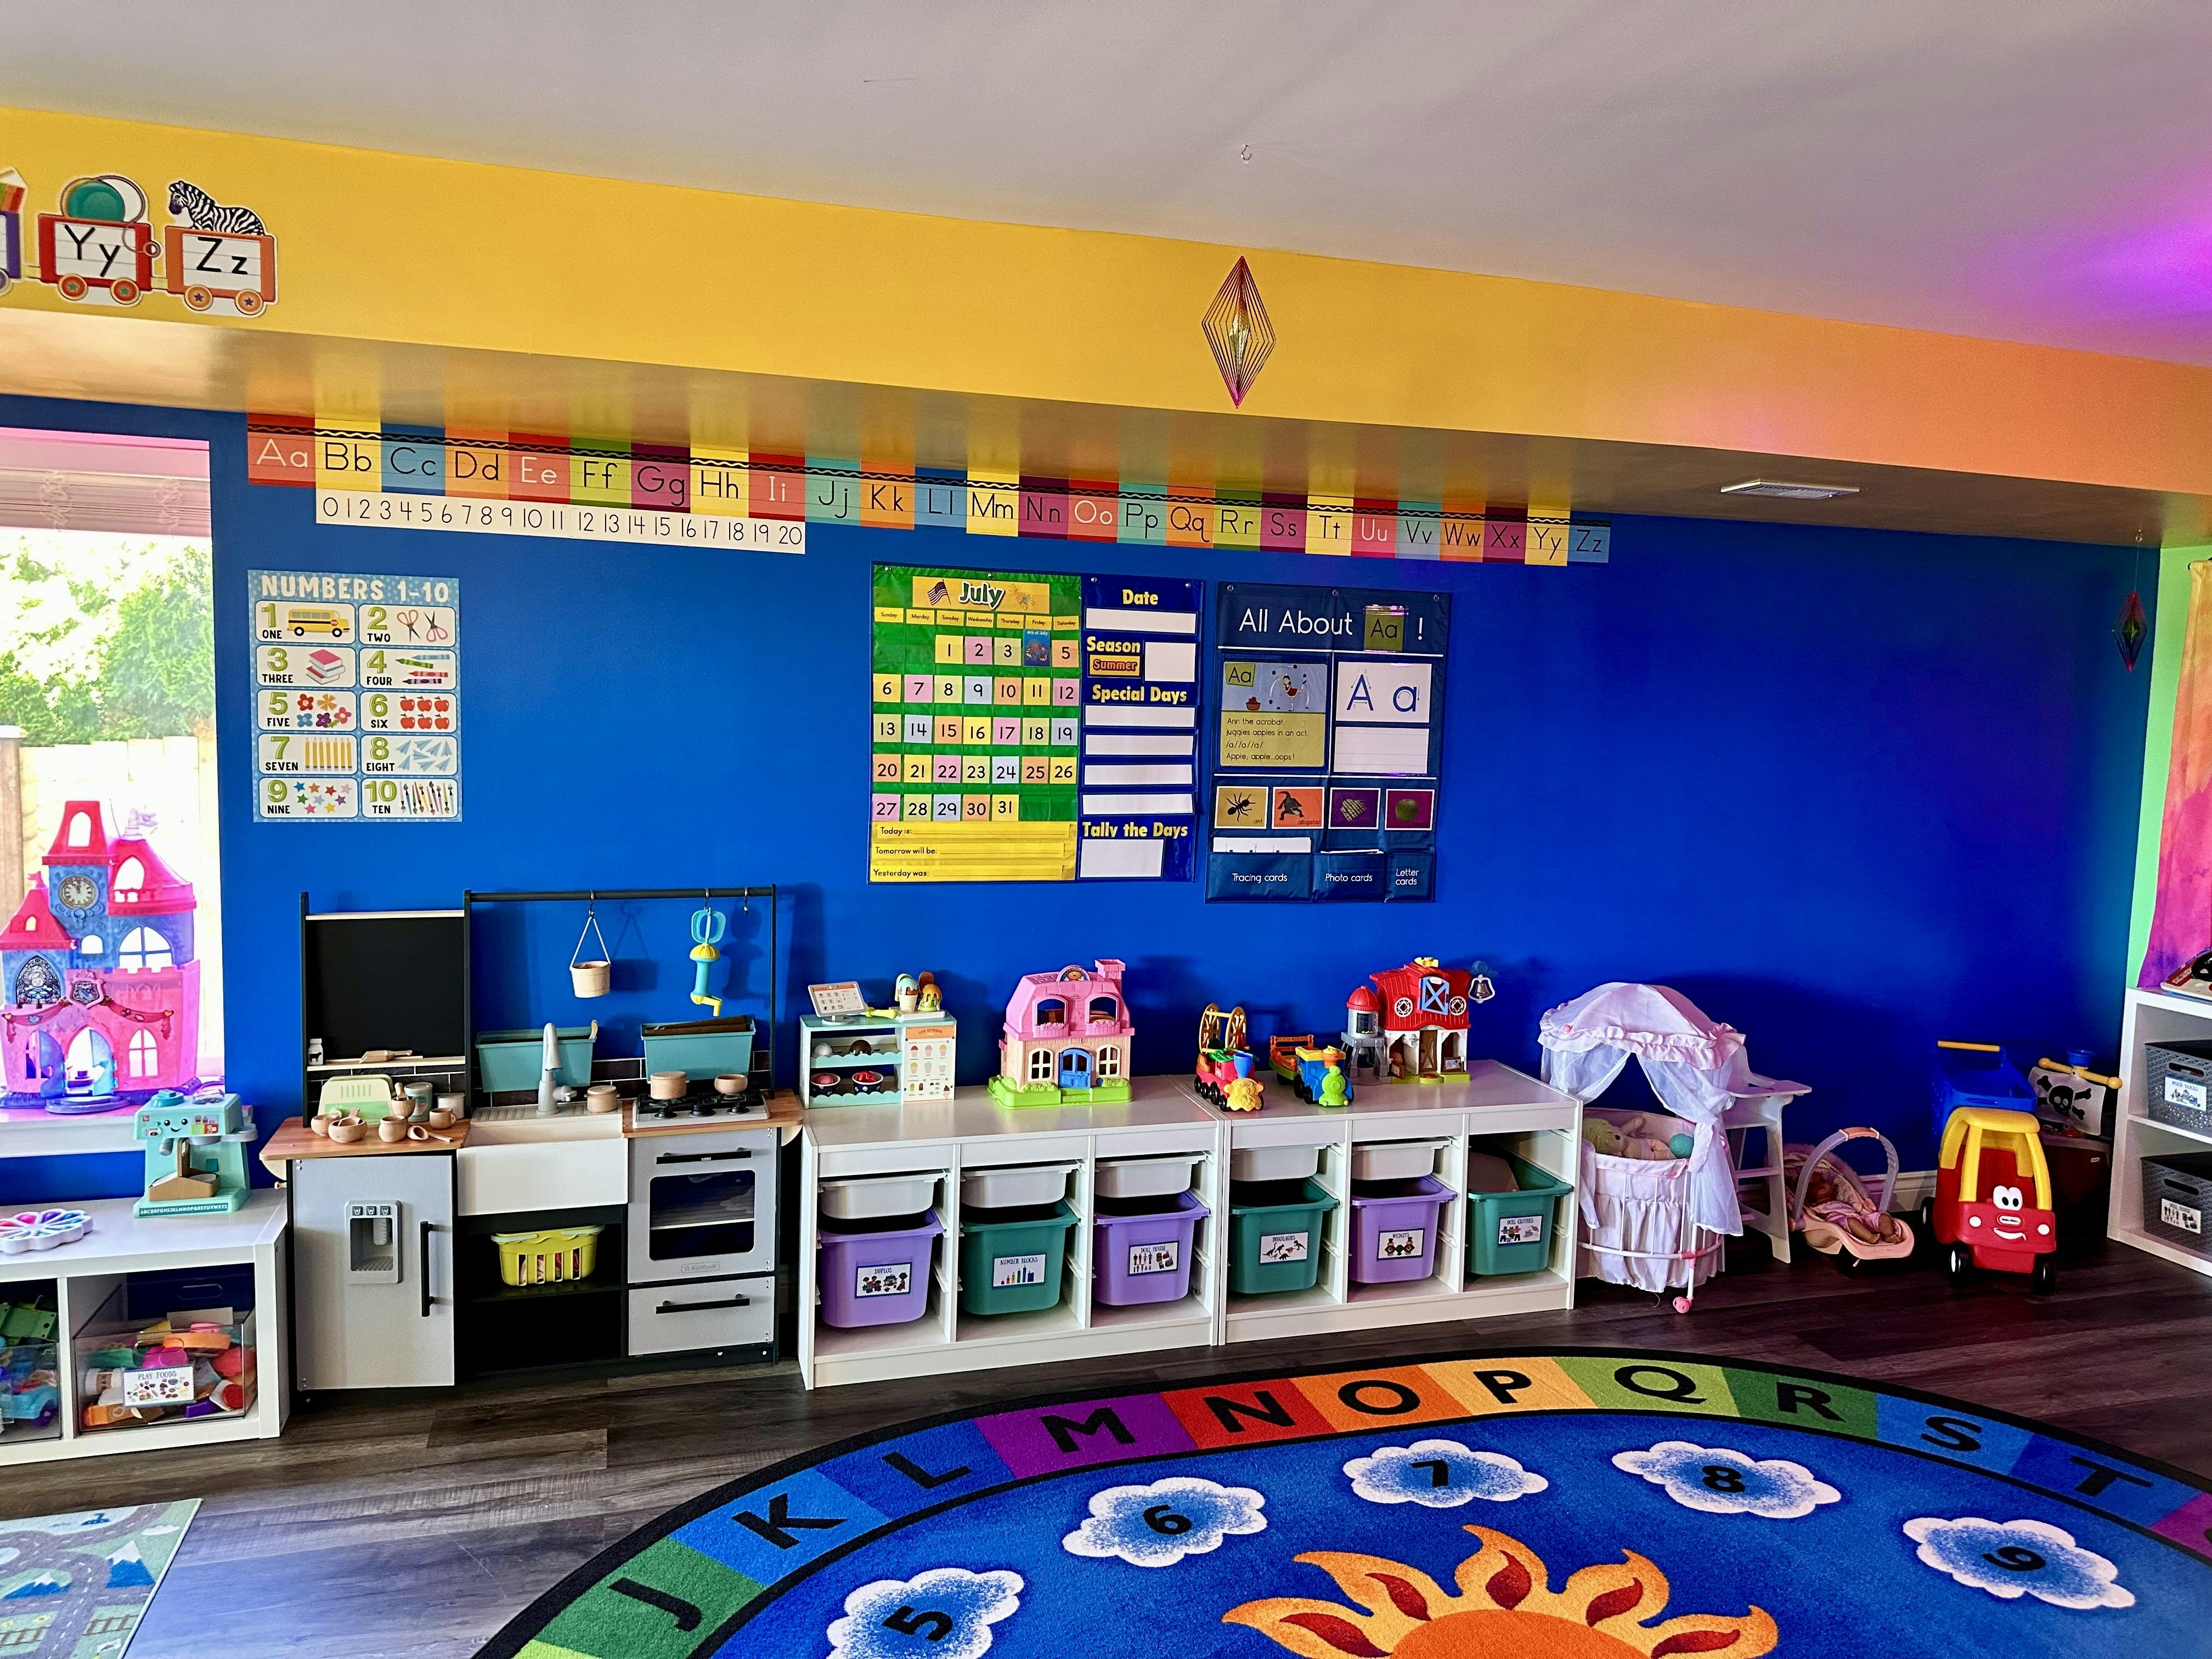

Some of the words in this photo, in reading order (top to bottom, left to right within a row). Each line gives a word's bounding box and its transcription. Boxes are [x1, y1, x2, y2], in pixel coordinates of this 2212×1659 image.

[64, 224, 120, 278] Yy
[196, 236, 248, 274] Zz
[256, 438, 308, 469] Aa
[325, 442, 371, 471] Bb
[391, 447, 436, 476] Cc
[455, 451, 499, 481] Dd
[521, 456, 557, 485] Ee
[583, 460, 618, 489] Ff
[637, 465, 685, 506] Gg
[701, 470, 738, 499] Hh
[769, 476, 786, 503] Ii
[818, 480, 849, 519] Jj
[871, 484, 904, 512] Kk
[928, 488, 953, 515] Ll
[972, 492, 1014, 520] Mm
[1026, 496, 1060, 523] Nn
[1074, 500, 1112, 526] Oo
[1125, 503, 1159, 539] Pp
[1170, 506, 1209, 543] Qq
[1220, 510, 1254, 536] Rr
[1269, 512, 1297, 537] Ss
[1318, 515, 1340, 540] Tt
[1361, 518, 1389, 543] Uu
[1406, 521, 1433, 545] Vv
[1444, 522, 1481, 547] Ww
[1491, 525, 1520, 549] Xx
[1533, 527, 1562, 561] Yy
[1576, 530, 1601, 554] Zz
[261, 574, 385, 601] NUMBERS
[398, 582, 449, 602] 1-10
[960, 582, 1005, 610] July
[1122, 589, 1158, 605] Date
[261, 603, 276, 628] 1
[367, 607, 388, 631] 2
[1239, 608, 1268, 633] All
[1278, 610, 1353, 636] About
[1370, 618, 1398, 639] Aa
[262, 630, 282, 640] ONE
[367, 633, 391, 642] TWO
[947, 644, 951, 657] 1
[975, 643, 984, 657] 2
[1003, 645, 1012, 657] 3
[1062, 646, 1070, 659] 5
[1086, 636, 1140, 653] Season
[267, 647, 288, 672] 3
[368, 650, 387, 674] 4
[1092, 659, 1138, 672] Summer
[262, 674, 294, 684] THREE
[366, 676, 392, 686] FOUR
[1228, 666, 1251, 684] Aa
[882, 681, 891, 695] 6
[913, 682, 924, 696] 7
[944, 682, 953, 696] 8
[973, 684, 983, 697] 9
[1001, 685, 1016, 698] 10
[1031, 684, 1042, 697] 11
[1059, 686, 1074, 699] 12
[1092, 684, 1144, 703] Special
[1150, 686, 1187, 704] Days
[1346, 674, 1374, 711] A
[1392, 686, 1417, 713] a
[269, 692, 287, 715] 5
[369, 694, 388, 717] 6
[267, 718, 290, 727] FIVE
[370, 720, 388, 729] SIX
[881, 722, 895, 736] 13
[911, 723, 927, 736] 14
[941, 724, 957, 737] 15
[970, 726, 985, 739] 16
[1000, 726, 1015, 740] 17
[1029, 726, 1044, 740] 18
[1058, 727, 1072, 740] 19
[270, 736, 290, 760] 7
[369, 737, 389, 760] 8
[266, 762, 298, 771] SEVEN
[366, 763, 395, 771] EIGHT
[877, 763, 897, 777] 20
[910, 764, 925, 778] 21
[938, 765, 957, 778] 22
[967, 766, 985, 778] 23
[996, 766, 1016, 779] 24
[1026, 766, 1045, 779] 25
[1054, 765, 1073, 778] 26
[267, 780, 287, 803] 9
[364, 781, 397, 803] 10
[267, 805, 290, 814] NINE
[372, 805, 391, 814] TEN
[876, 803, 897, 816] 27
[908, 803, 928, 816] 28
[938, 803, 957, 816] 29
[967, 803, 986, 816] 30
[998, 800, 1012, 814] 31
[881, 827, 903, 837] Today
[1082, 822, 1118, 837] Tally
[1123, 822, 1148, 837] the
[1153, 822, 1188, 839] Days
[875, 847, 911, 855] Tomorrow
[873, 869, 911, 878] Yesterday
[1232, 873, 1262, 884] Tracing
[1264, 873, 1288, 882] cards
[1325, 873, 1348, 882] Photo
[1351, 873, 1373, 882] cards
[1395, 877, 1418, 885] cards
[1396, 868, 1419, 877] Letter
[1410, 1459, 1449, 1488] 7
[1700, 1465, 1746, 1494] 8
[607, 1577, 702, 1633] J
[731, 1492, 848, 1551] K
[881, 1451, 973, 1489] L
[1040, 1407, 1137, 1454] M
[1203, 1390, 1295, 1434] N
[1338, 1379, 1420, 1415] O
[1472, 1369, 1532, 1405] P
[1613, 1365, 1707, 1404] Q
[1776, 1381, 1846, 1423] R
[1921, 1415, 1982, 1453] S
[2069, 1455, 2153, 1497] T
[1142, 1505, 1193, 1536] 6
[1982, 1547, 2046, 1572] 9
[882, 1605, 953, 1642] 5
